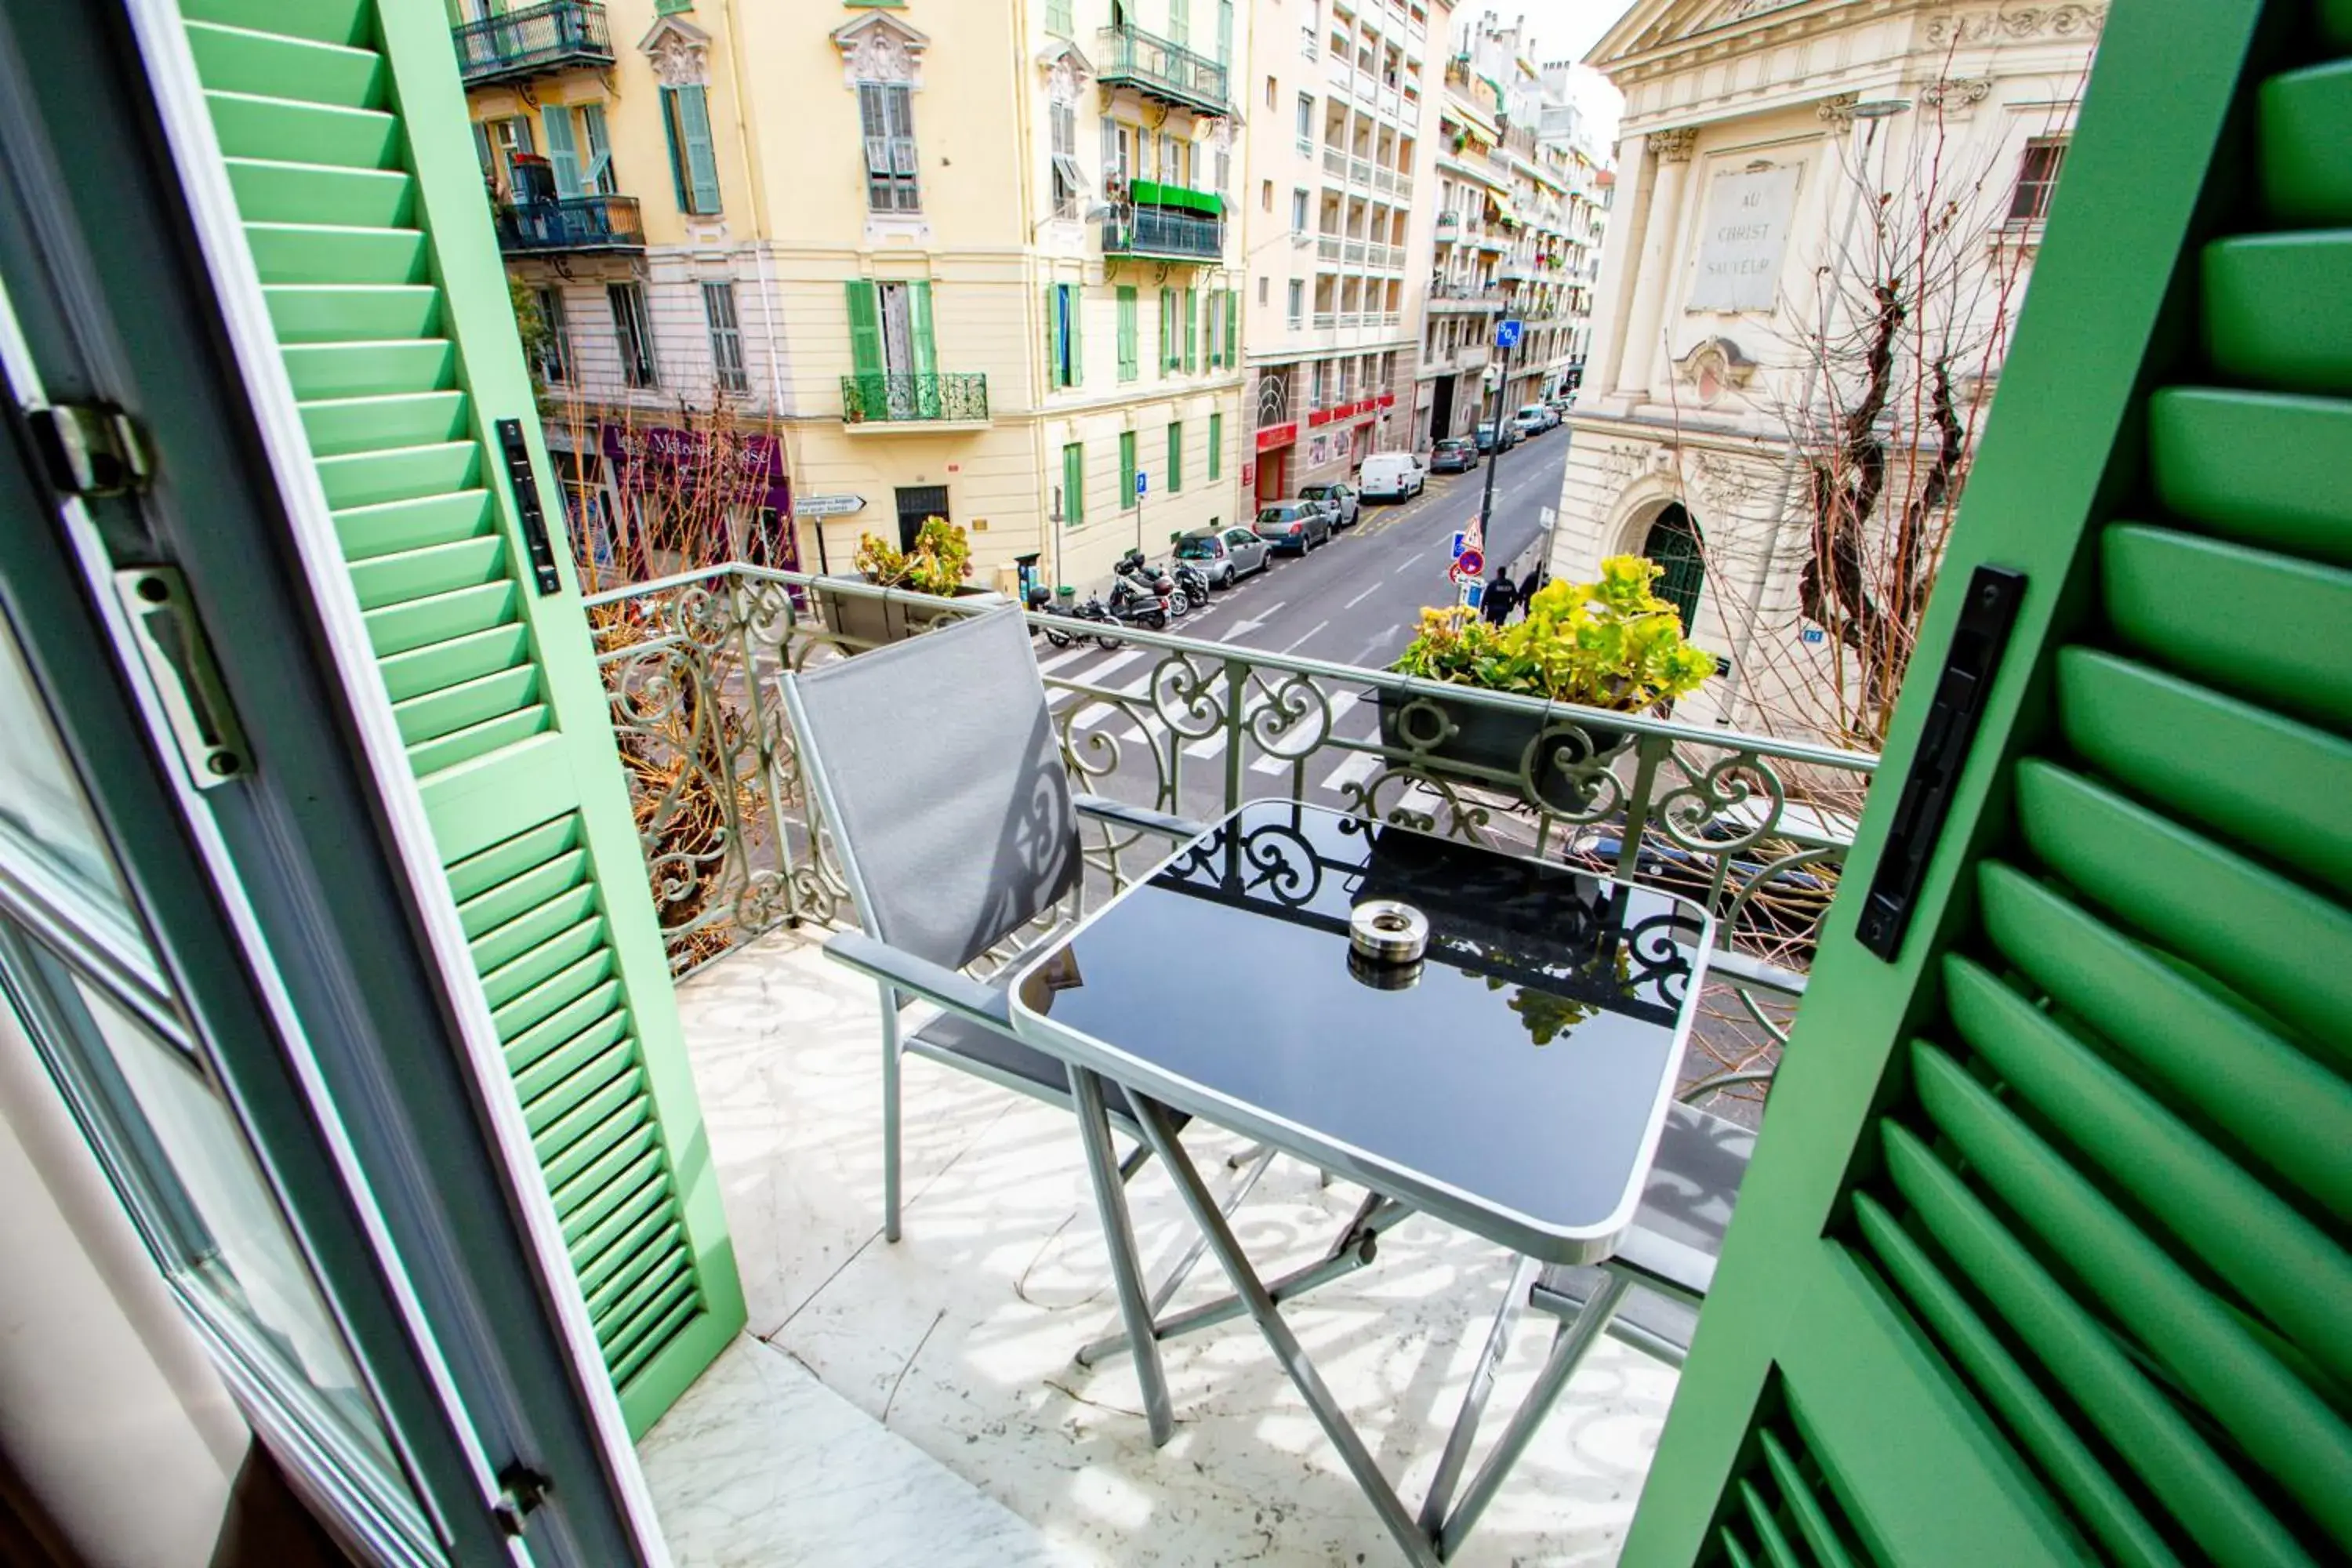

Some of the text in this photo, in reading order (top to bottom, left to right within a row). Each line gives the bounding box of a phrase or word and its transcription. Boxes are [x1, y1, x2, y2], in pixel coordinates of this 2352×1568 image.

[1742, 191, 1762, 207] AU
[1718, 223, 1769, 241] CHRIST
[1500, 321, 1518, 346] SOS
